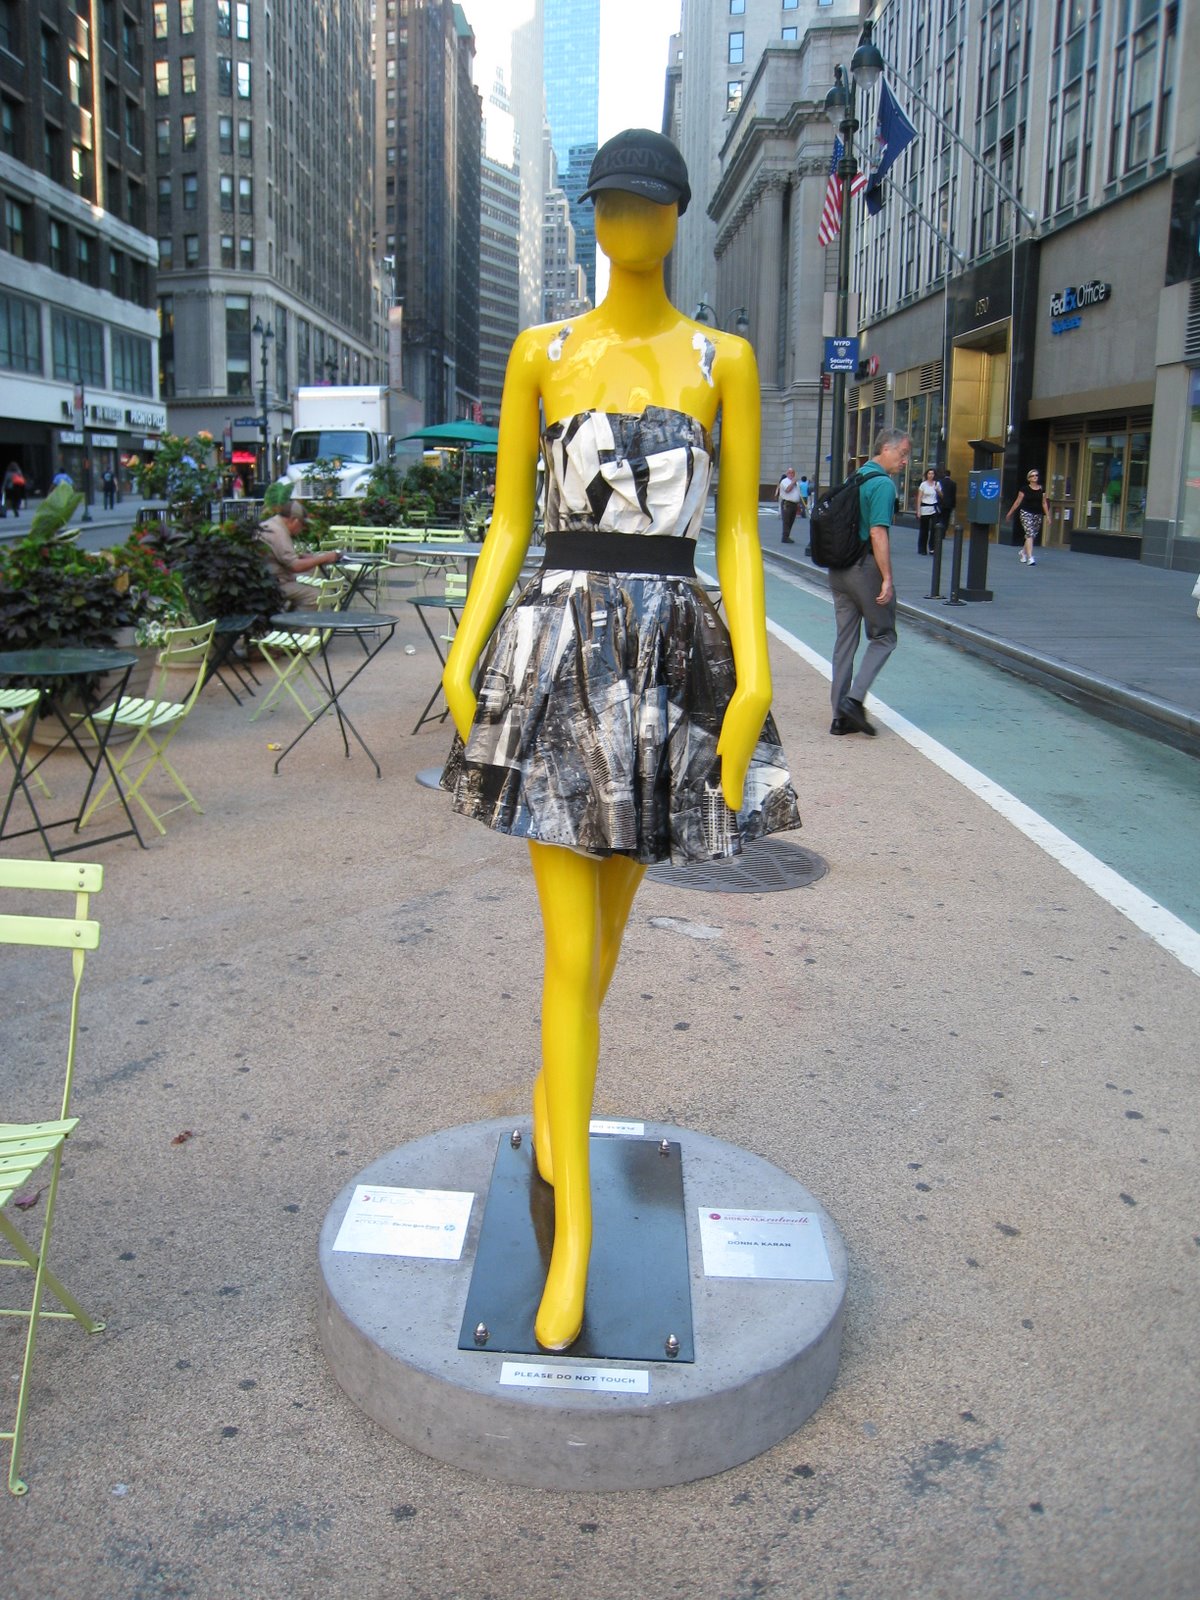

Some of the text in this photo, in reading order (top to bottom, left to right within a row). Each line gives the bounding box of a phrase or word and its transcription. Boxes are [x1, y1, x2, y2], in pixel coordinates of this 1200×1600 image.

[1049, 281, 1108, 317] FedEx Office
[829, 357, 853, 366] Security
[514, 1371, 553, 1379] PLEASE
